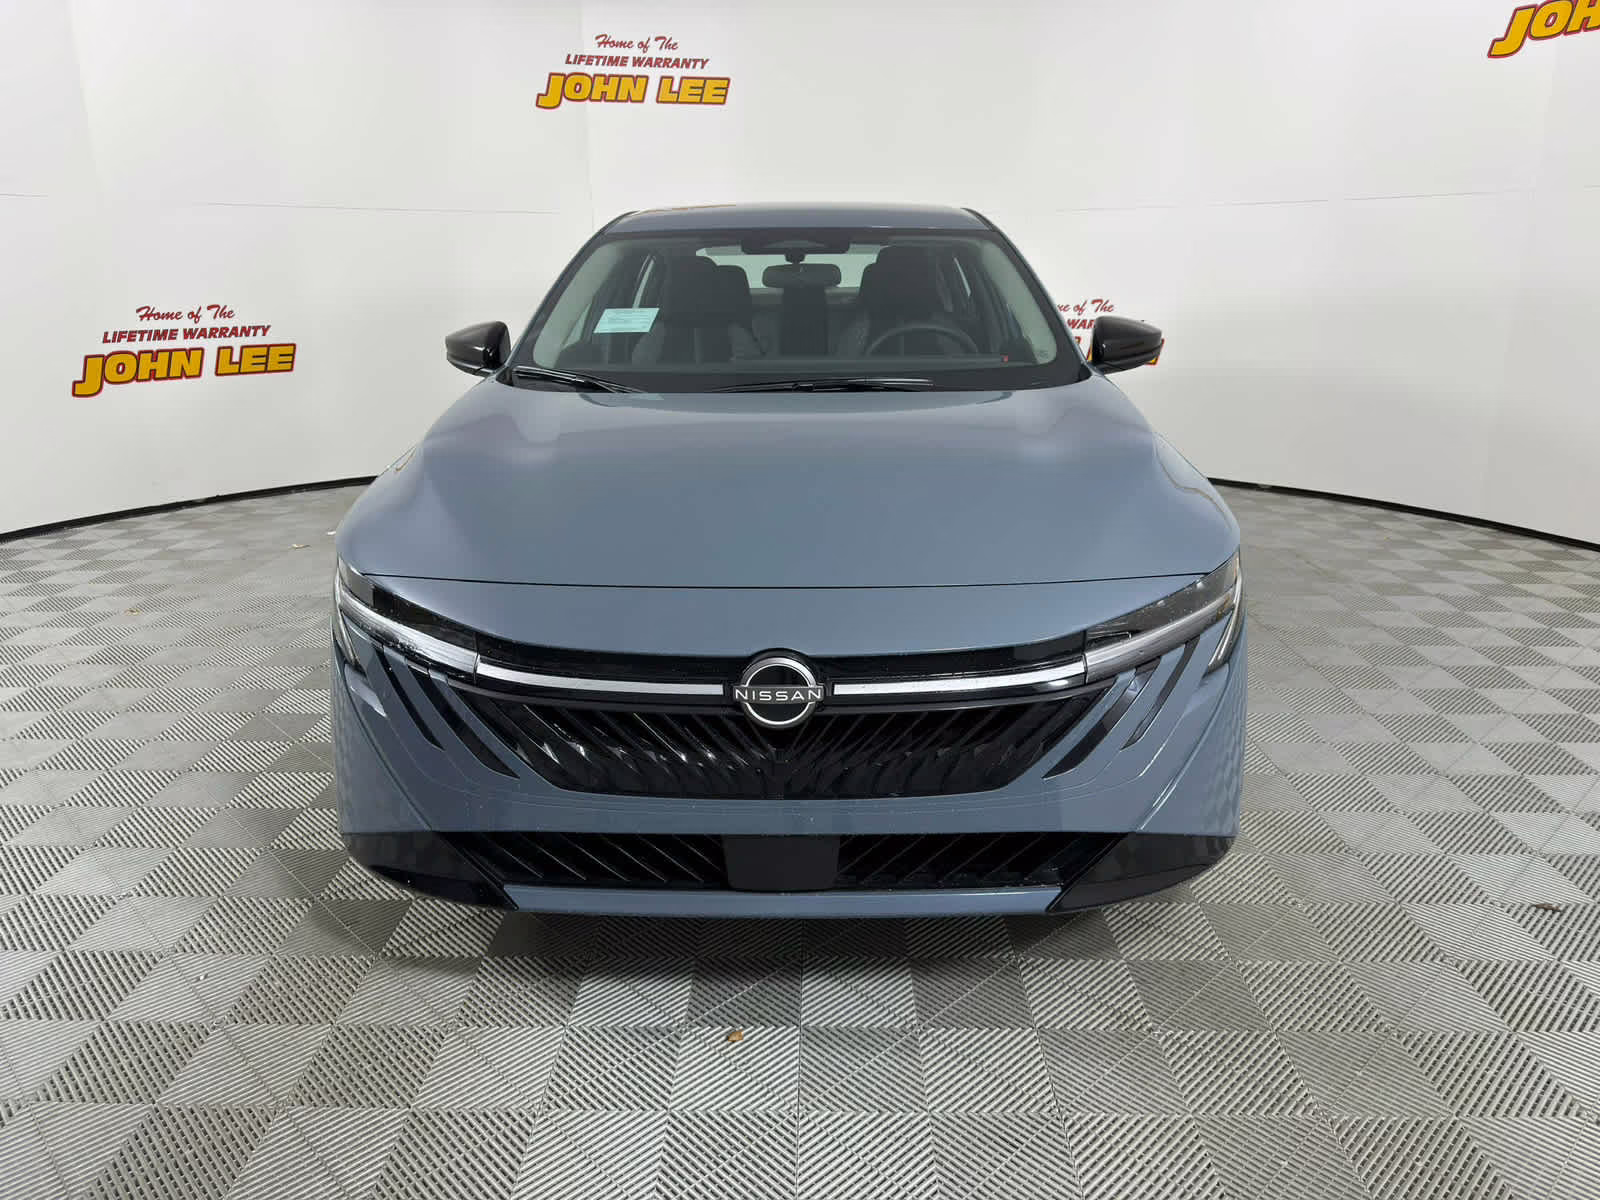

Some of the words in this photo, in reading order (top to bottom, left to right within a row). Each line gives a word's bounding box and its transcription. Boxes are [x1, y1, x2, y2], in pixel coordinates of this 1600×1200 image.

[1487, 0, 1600, 58] JOH
[595, 34, 634, 49] Home
[637, 36, 650, 53] of
[654, 36, 679, 50] The
[565, 54, 628, 67] LIFETIME
[632, 56, 709, 69] WARRANTY
[536, 72, 649, 109] JOHN
[656, 76, 731, 105] LEE
[136, 305, 183, 321] Home
[187, 305, 202, 324] of
[206, 304, 235, 320] The
[1073, 300, 1087, 316] of
[1091, 299, 1115, 313] The
[102, 328, 178, 344] LIFETIME
[183, 325, 271, 340] WARRANTY
[72, 347, 204, 397] JOHN
[215, 343, 296, 376] LEE
[735, 689, 821, 700] NISSAN
